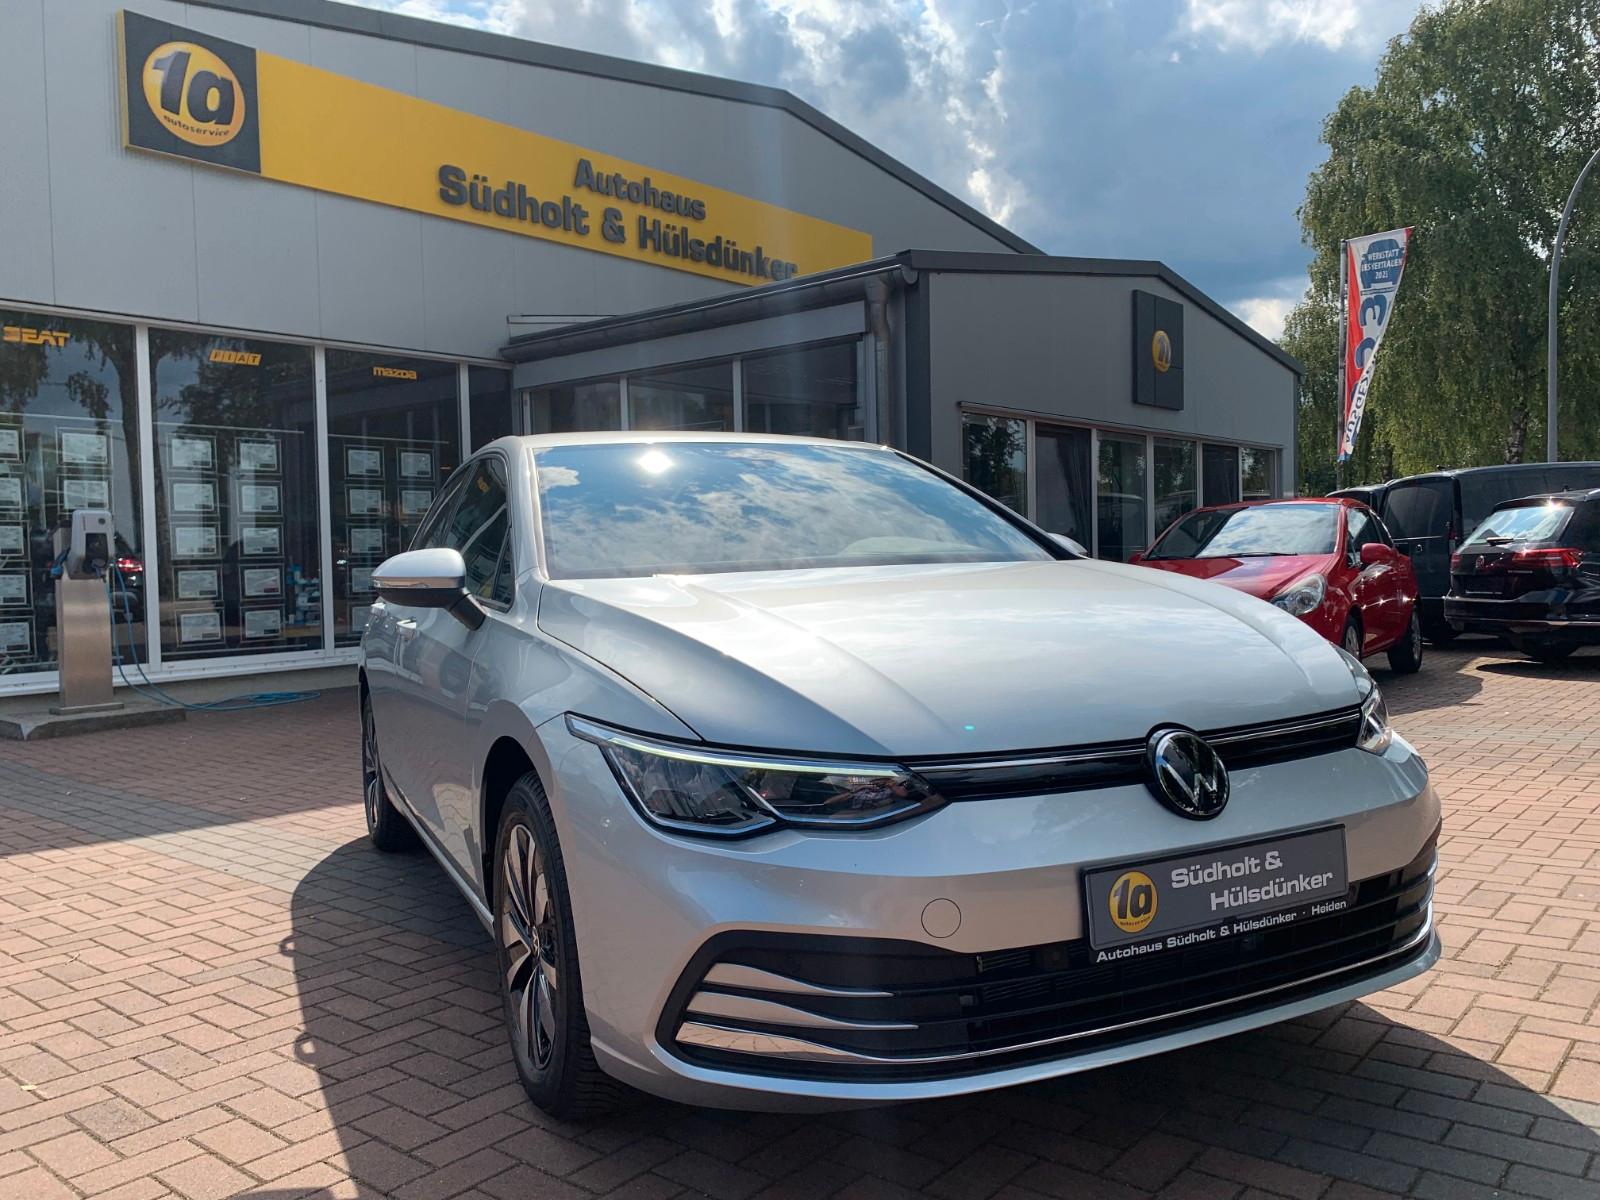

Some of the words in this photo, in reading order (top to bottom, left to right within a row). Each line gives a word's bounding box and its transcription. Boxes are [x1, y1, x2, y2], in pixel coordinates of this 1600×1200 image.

[152, 51, 235, 126] 1a
[163, 115, 231, 137] autoservice
[575, 158, 707, 221] Autohaus
[438, 164, 590, 236] Südholt
[602, 207, 627, 244] &
[638, 215, 798, 281] Hülsdünker
[3, 325, 71, 347] SEAT
[1171, 854, 1261, 889] Südholt
[1264, 850, 1283, 871] &
[1210, 869, 1333, 911] Hülsdünker
[1113, 878, 1152, 919] 1a
[1096, 940, 1163, 963] Autohaus
[1167, 929, 1216, 950] Südholt
[1220, 925, 1230, 937] &
[1233, 910, 1297, 935] Hülsdünker
[1311, 899, 1347, 917] Heiden
